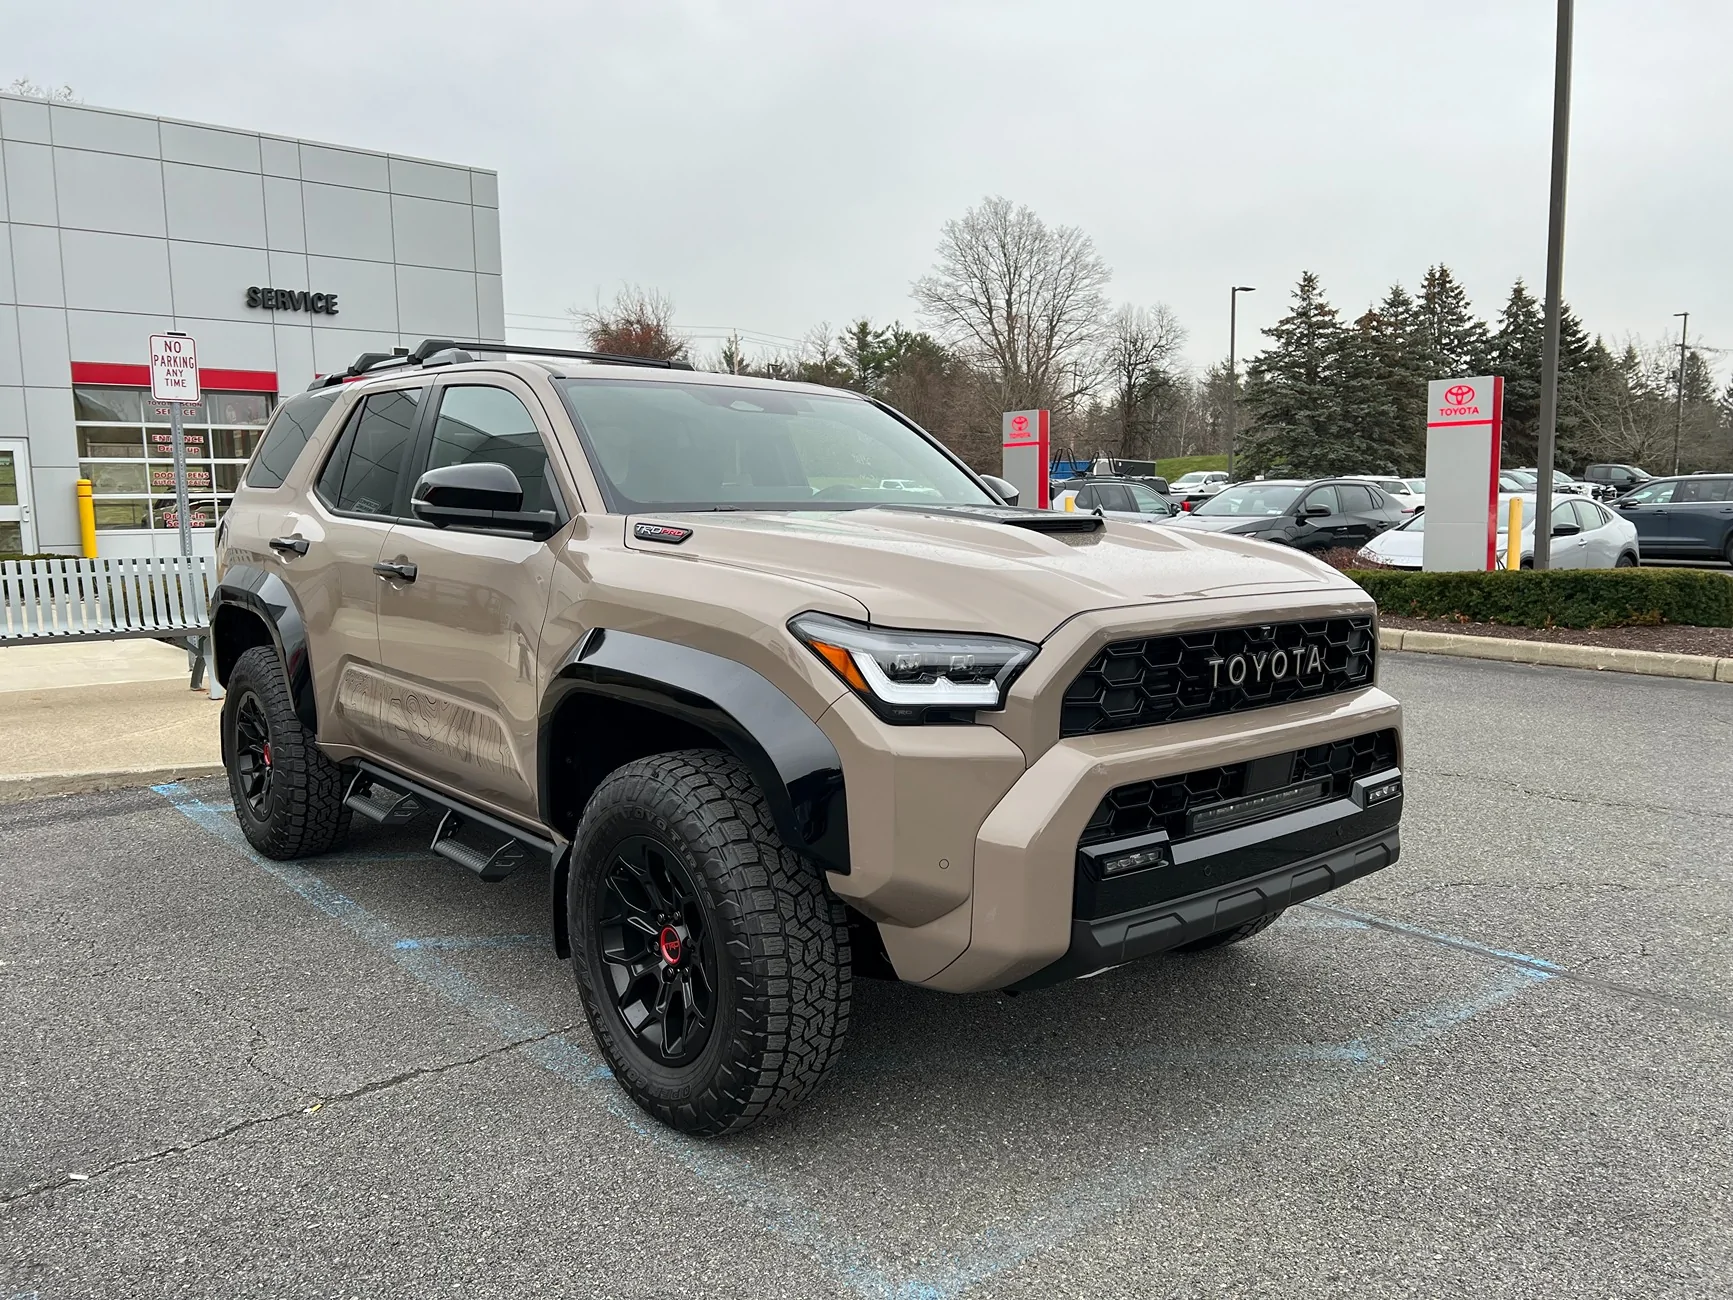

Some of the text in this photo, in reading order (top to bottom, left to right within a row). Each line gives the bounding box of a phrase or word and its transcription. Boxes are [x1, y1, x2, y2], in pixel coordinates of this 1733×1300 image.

[246, 286, 339, 315] SERVICE
[164, 340, 182, 353] NO
[153, 354, 195, 369] PARKING
[166, 368, 184, 377] ANY
[164, 378, 187, 388] TIME
[1439, 407, 1479, 417] TOYOTA
[152, 435, 204, 443] ENTNCE
[636, 524, 685, 537] TRD PRO
[1207, 647, 1322, 689] TOYOTA
[623, 804, 668, 831] TOYO
[664, 941, 680, 950] TRD
